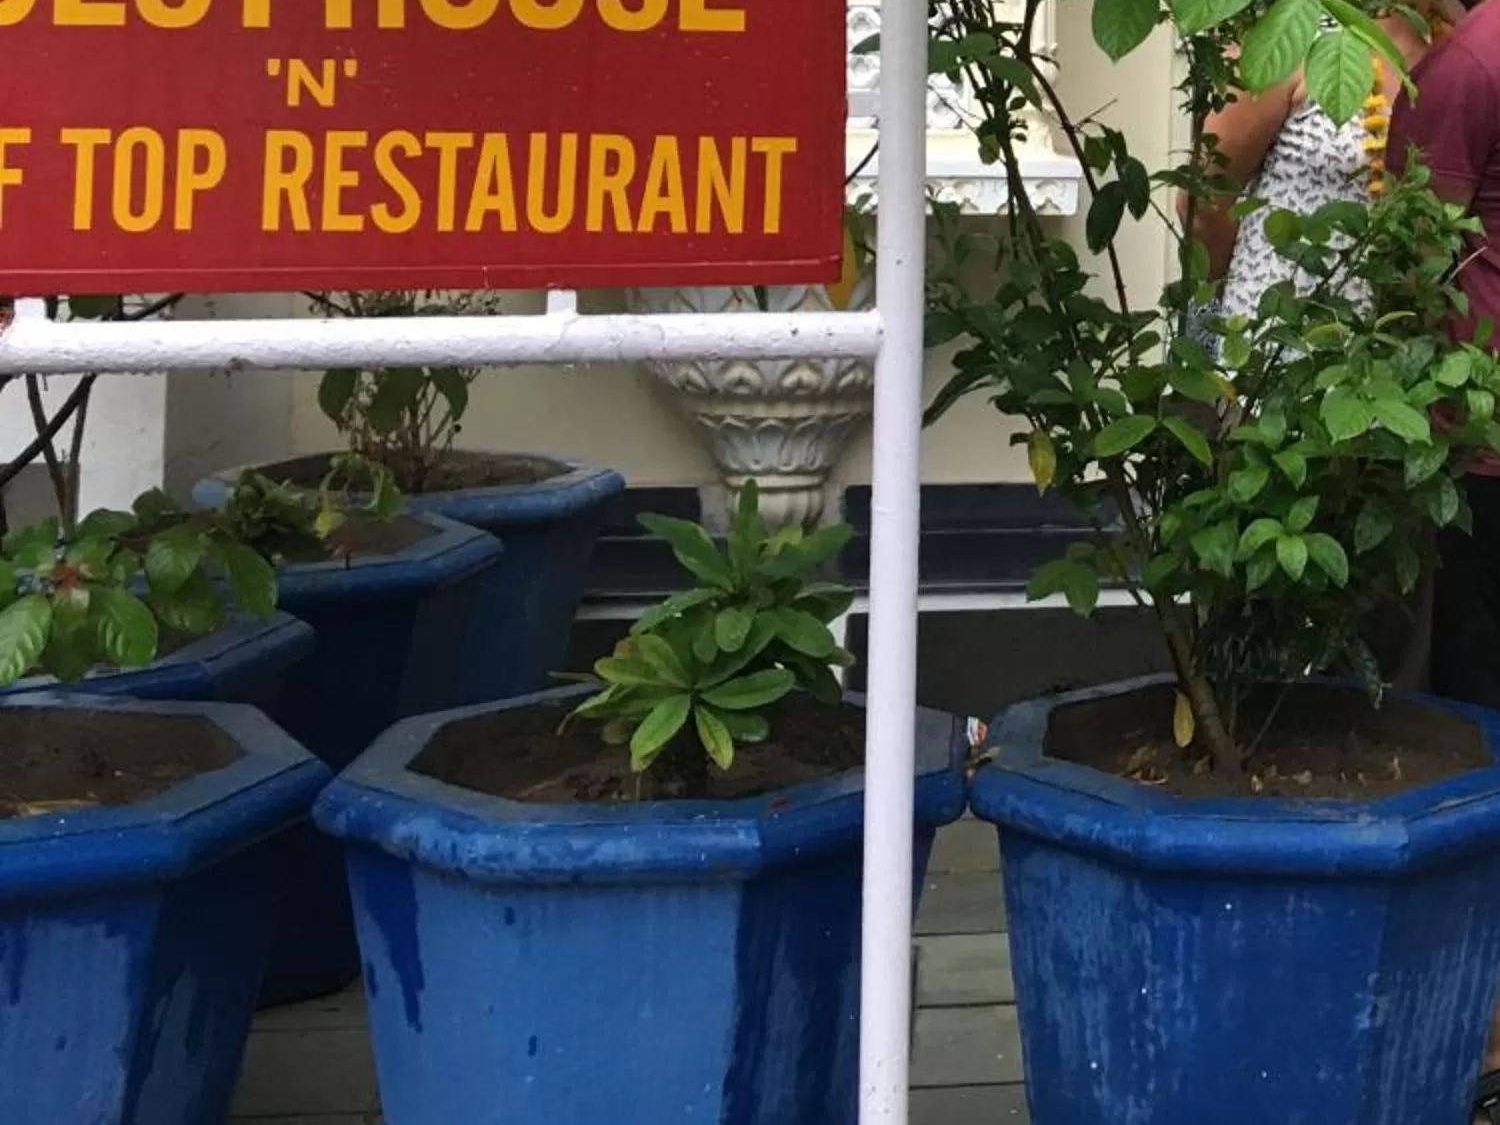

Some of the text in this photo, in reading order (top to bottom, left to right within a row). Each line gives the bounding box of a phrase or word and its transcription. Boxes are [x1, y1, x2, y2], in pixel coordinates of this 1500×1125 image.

[266, 56, 359, 108] 'N'
[61, 127, 227, 231] TOP
[262, 129, 799, 234] RESTAURANT
